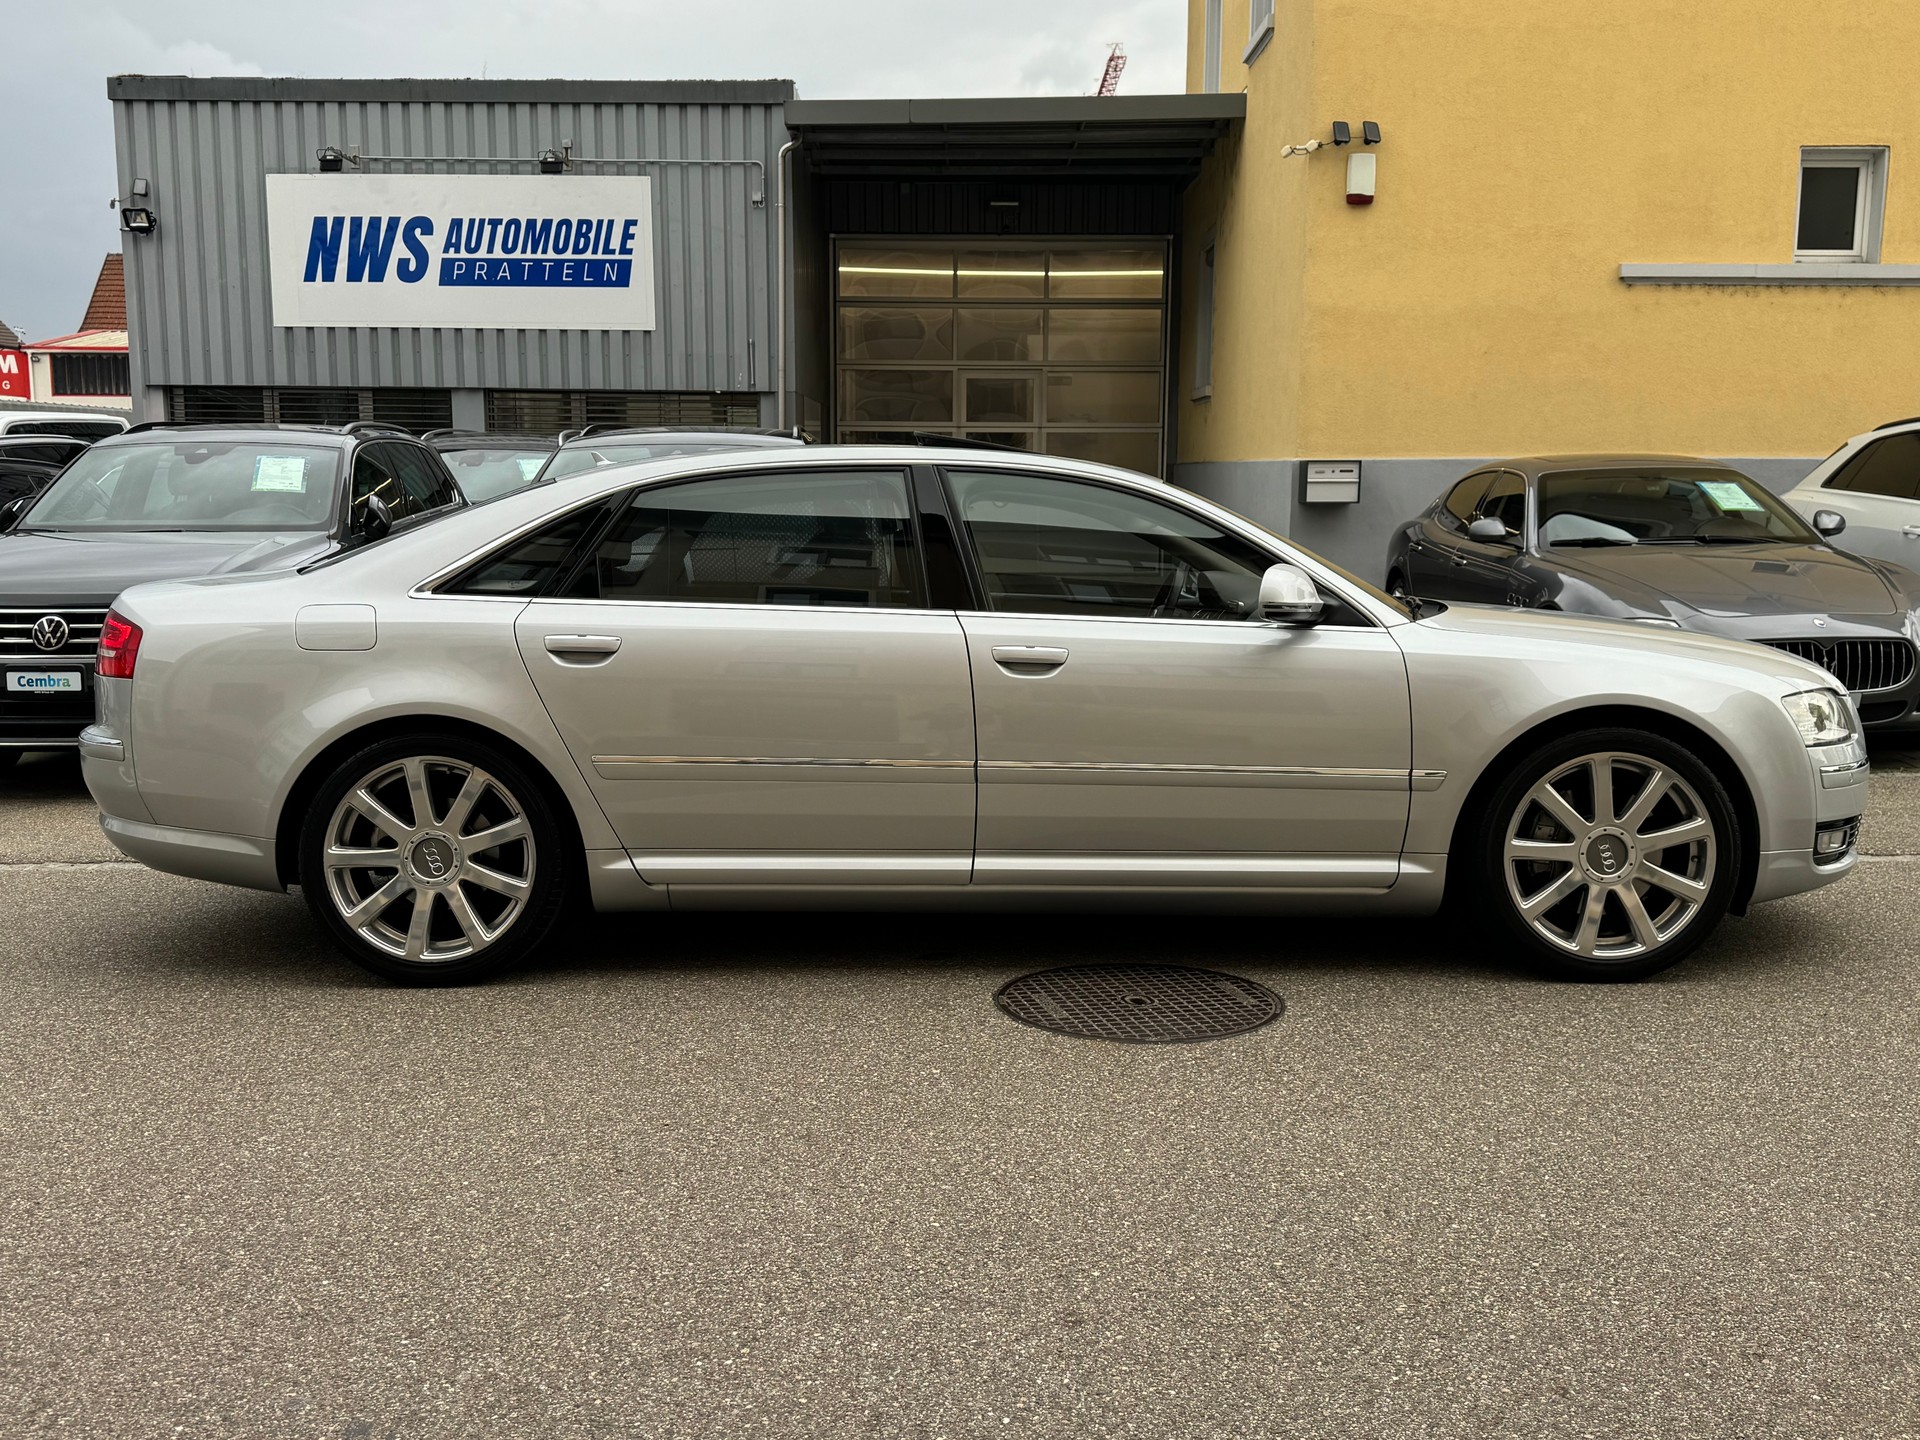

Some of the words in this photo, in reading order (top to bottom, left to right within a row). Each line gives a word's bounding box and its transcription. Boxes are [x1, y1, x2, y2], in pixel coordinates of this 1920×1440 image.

[303, 216, 434, 283] NWS
[442, 218, 638, 255] AUTOMOBILE
[453, 261, 619, 282] PRATTELN
[17, 675, 71, 687] Cembra
